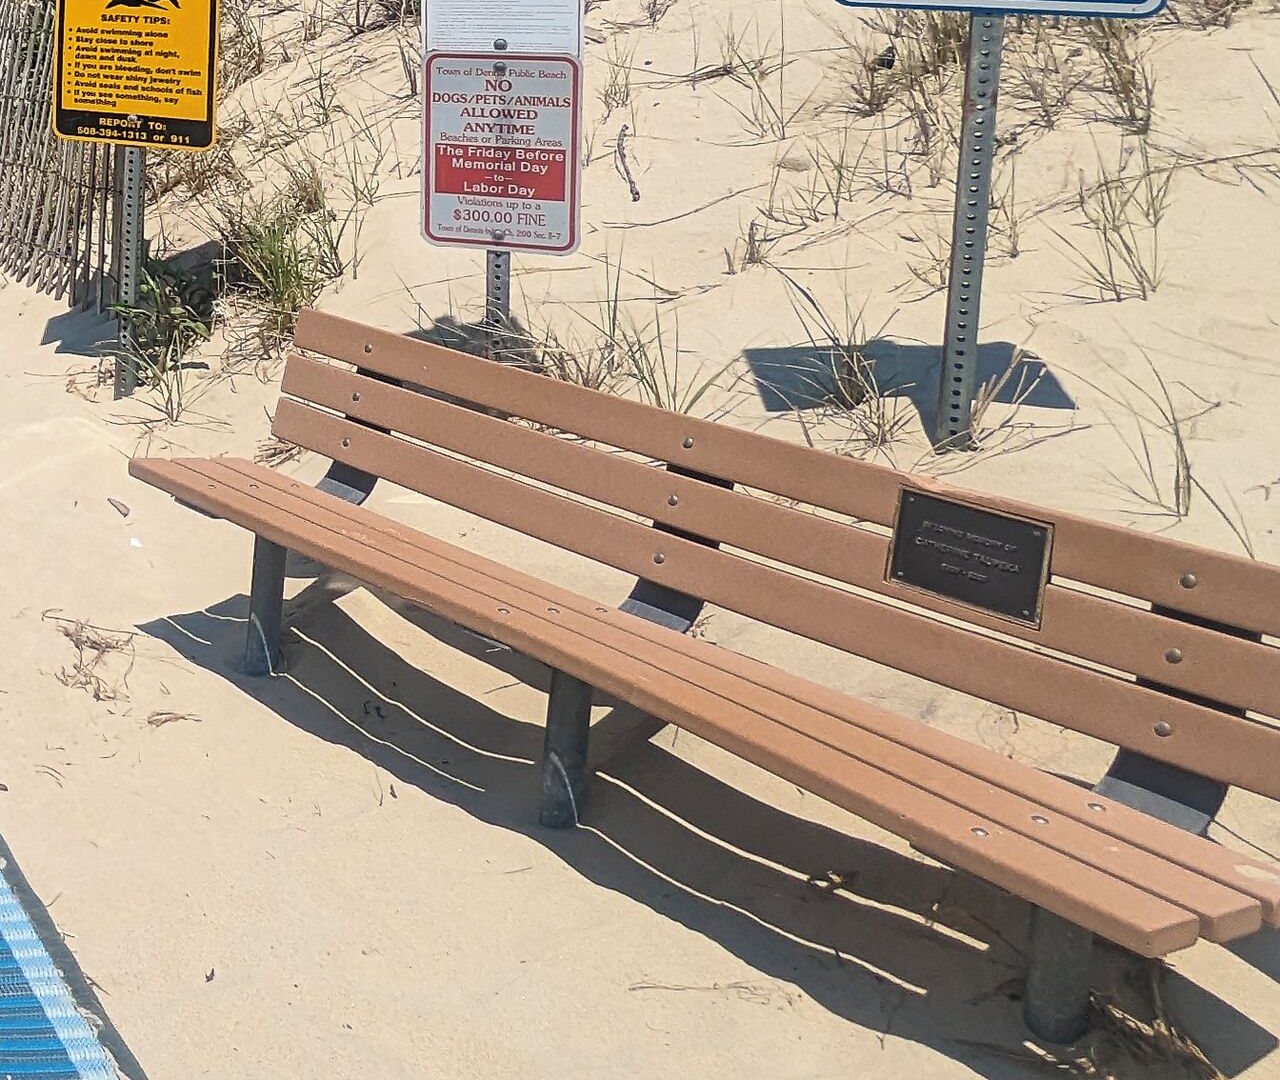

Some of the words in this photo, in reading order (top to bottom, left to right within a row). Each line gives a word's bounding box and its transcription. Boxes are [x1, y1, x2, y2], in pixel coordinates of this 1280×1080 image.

[101, 14, 139, 23] SAFETY
[143, 16, 170, 24] TIPS:
[436, 67, 461, 76] Town
[464, 68, 472, 76] of
[509, 69, 535, 78] Public
[539, 70, 566, 79] Beach
[485, 80, 512, 92] NO
[433, 92, 571, 107] DOGS/PETS/ANIMALS
[461, 108, 538, 120] ALLOWED
[148, 122, 167, 131] TO:
[464, 122, 535, 135] ANYTIME
[153, 134, 165, 142] or
[171, 135, 190, 143] 911
[440, 132, 478, 142] Beaches
[496, 136, 531, 147] Parking
[535, 137, 562, 146] Areas
[437, 145, 463, 156] The
[468, 147, 511, 159] Friday
[516, 149, 564, 161] Before
[451, 158, 516, 171] Memorial
[521, 162, 548, 174] Day
[463, 181, 504, 194] Labor
[508, 186, 535, 197] Day
[458, 196, 503, 207] Violations
[506, 201, 518, 210] up
[523, 202, 531, 210] to
[453, 209, 513, 223] $300.00
[517, 213, 546, 226] FINE
